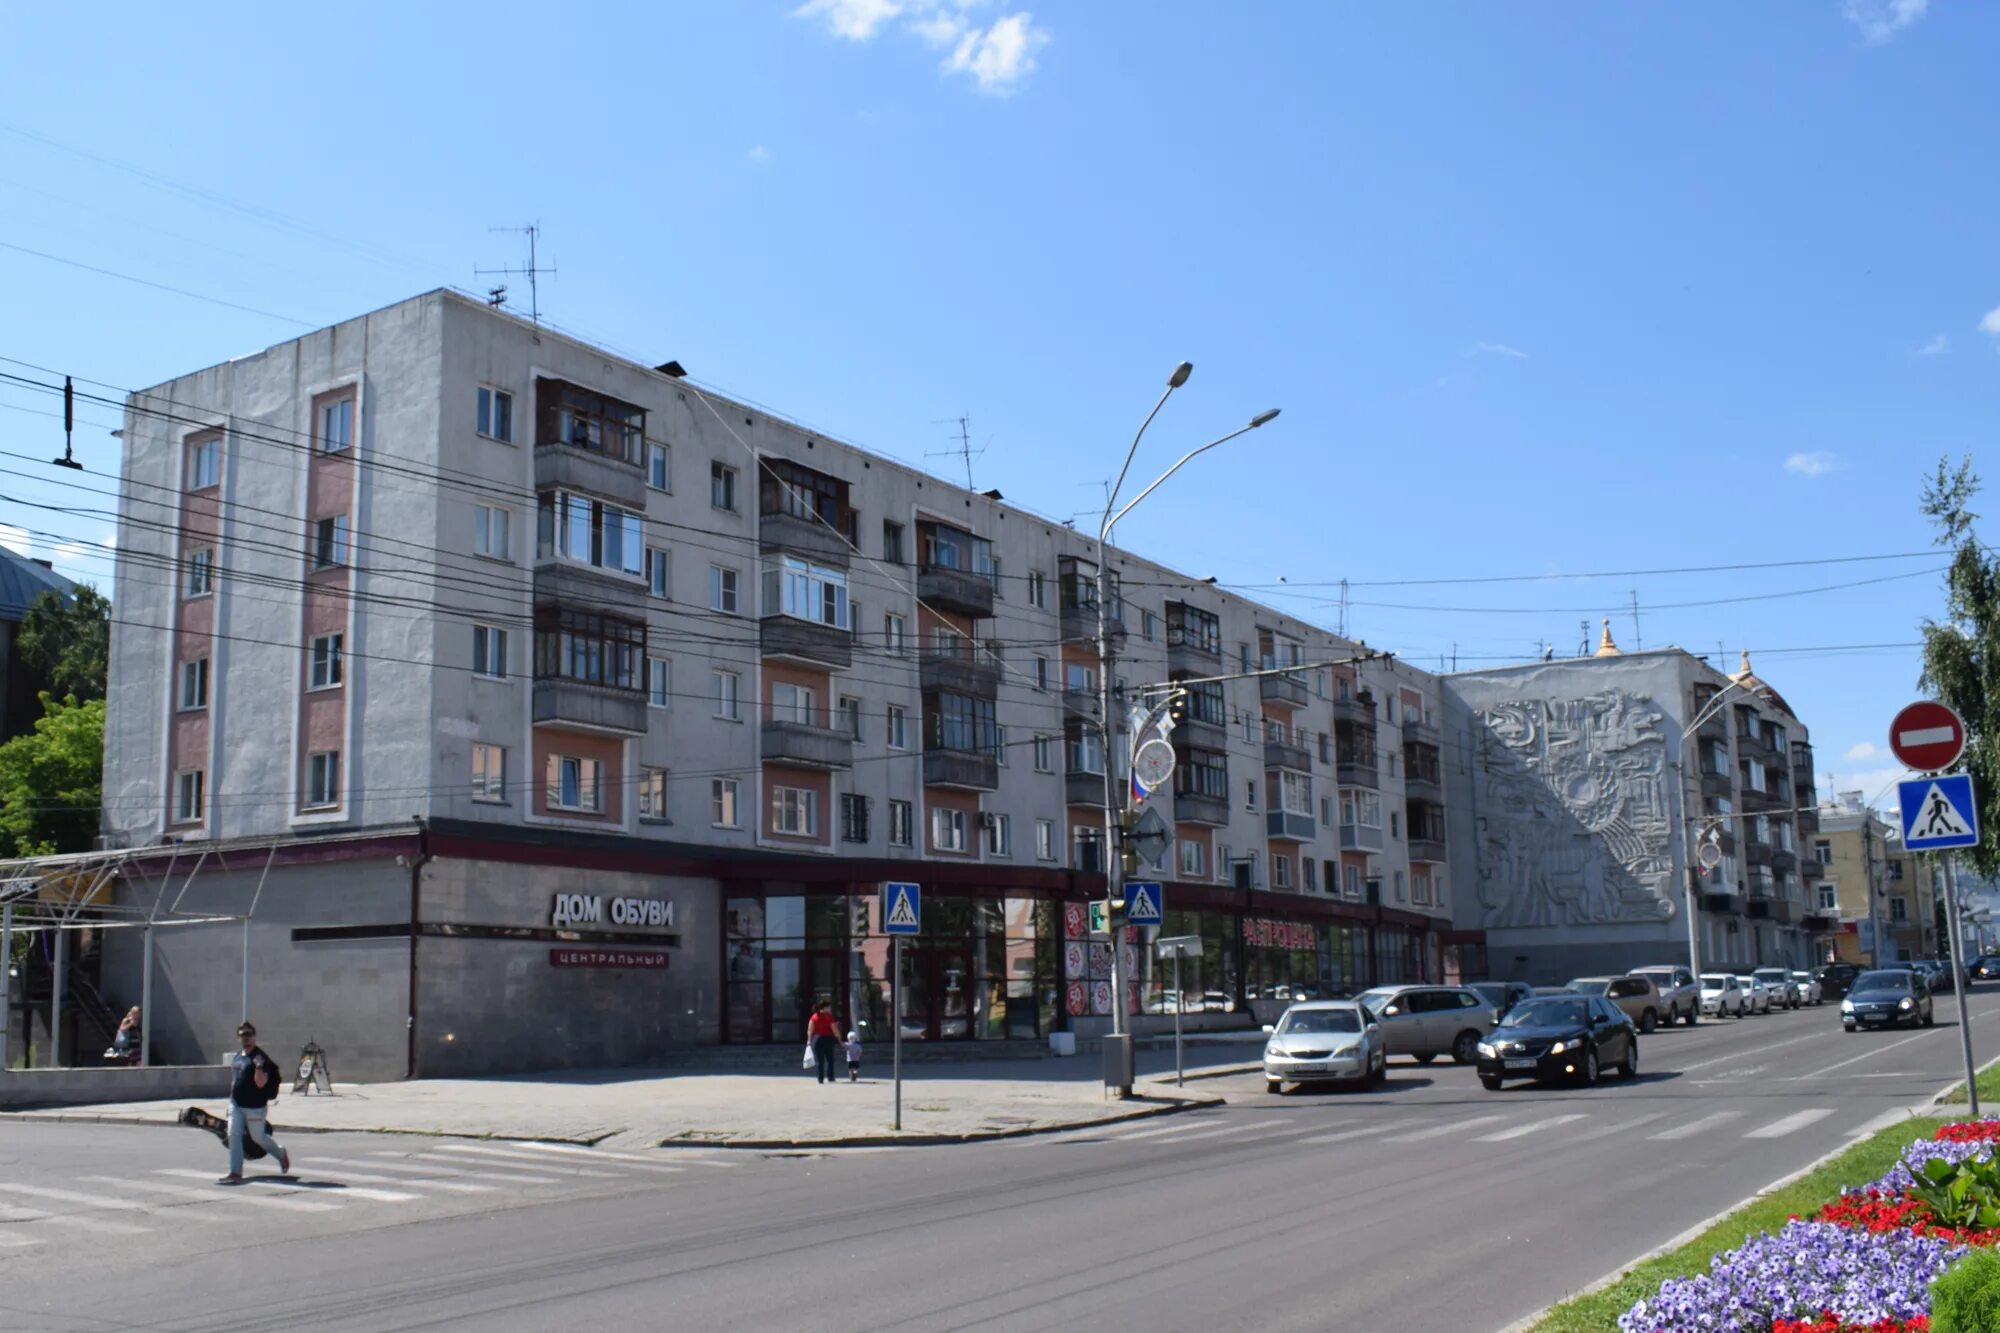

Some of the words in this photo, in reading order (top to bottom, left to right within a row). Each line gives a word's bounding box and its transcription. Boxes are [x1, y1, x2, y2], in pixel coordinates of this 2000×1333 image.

[552, 893, 601, 927] ДОМ
[611, 896, 673, 926] ОБУВИ
[559, 952, 665, 966] ЦЕНТРАЛЬНЫЙ
